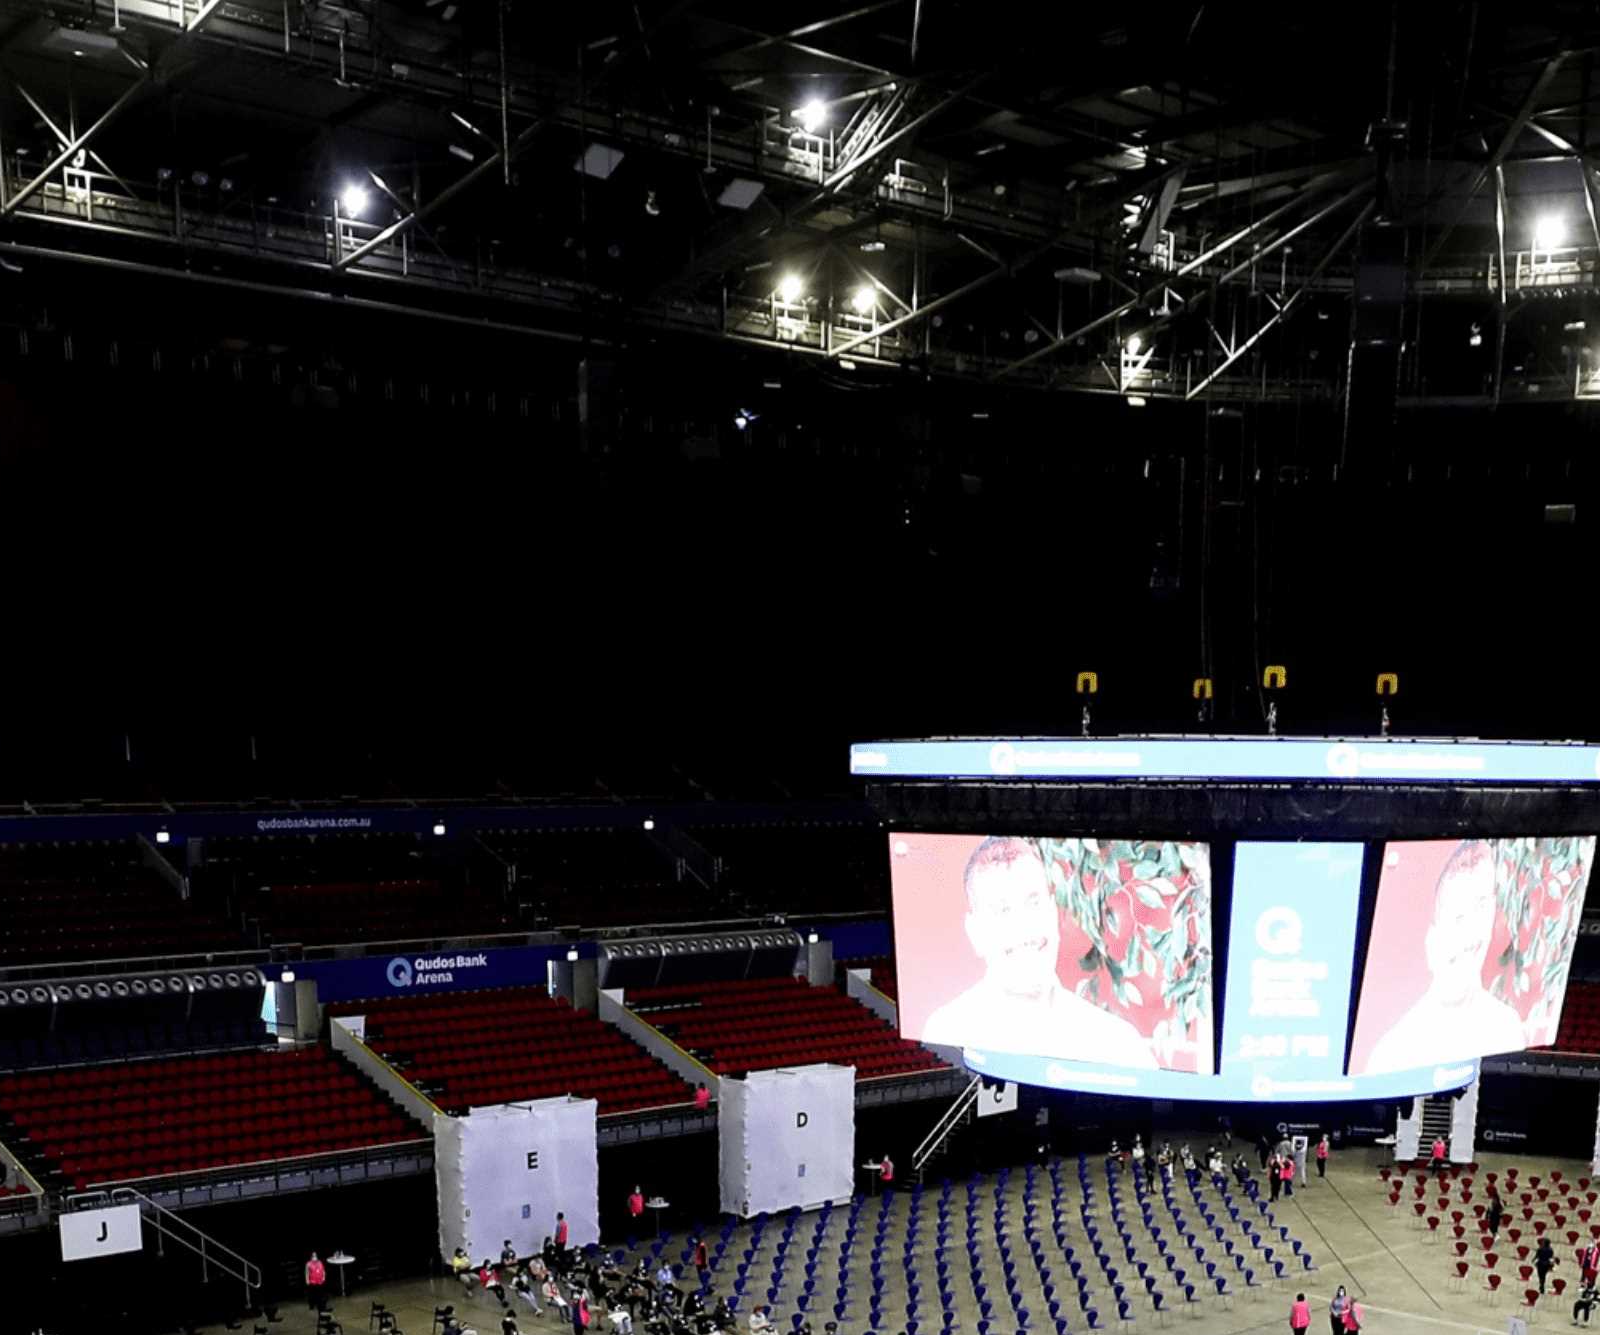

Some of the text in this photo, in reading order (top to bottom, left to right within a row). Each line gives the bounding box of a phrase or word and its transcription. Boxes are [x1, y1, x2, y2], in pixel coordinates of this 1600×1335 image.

[414, 953, 488, 971] Qudos Bank
[415, 971, 454, 985] Arena
[797, 1112, 808, 1128] D
[527, 1152, 538, 1169] E
[96, 1222, 107, 1242] J
